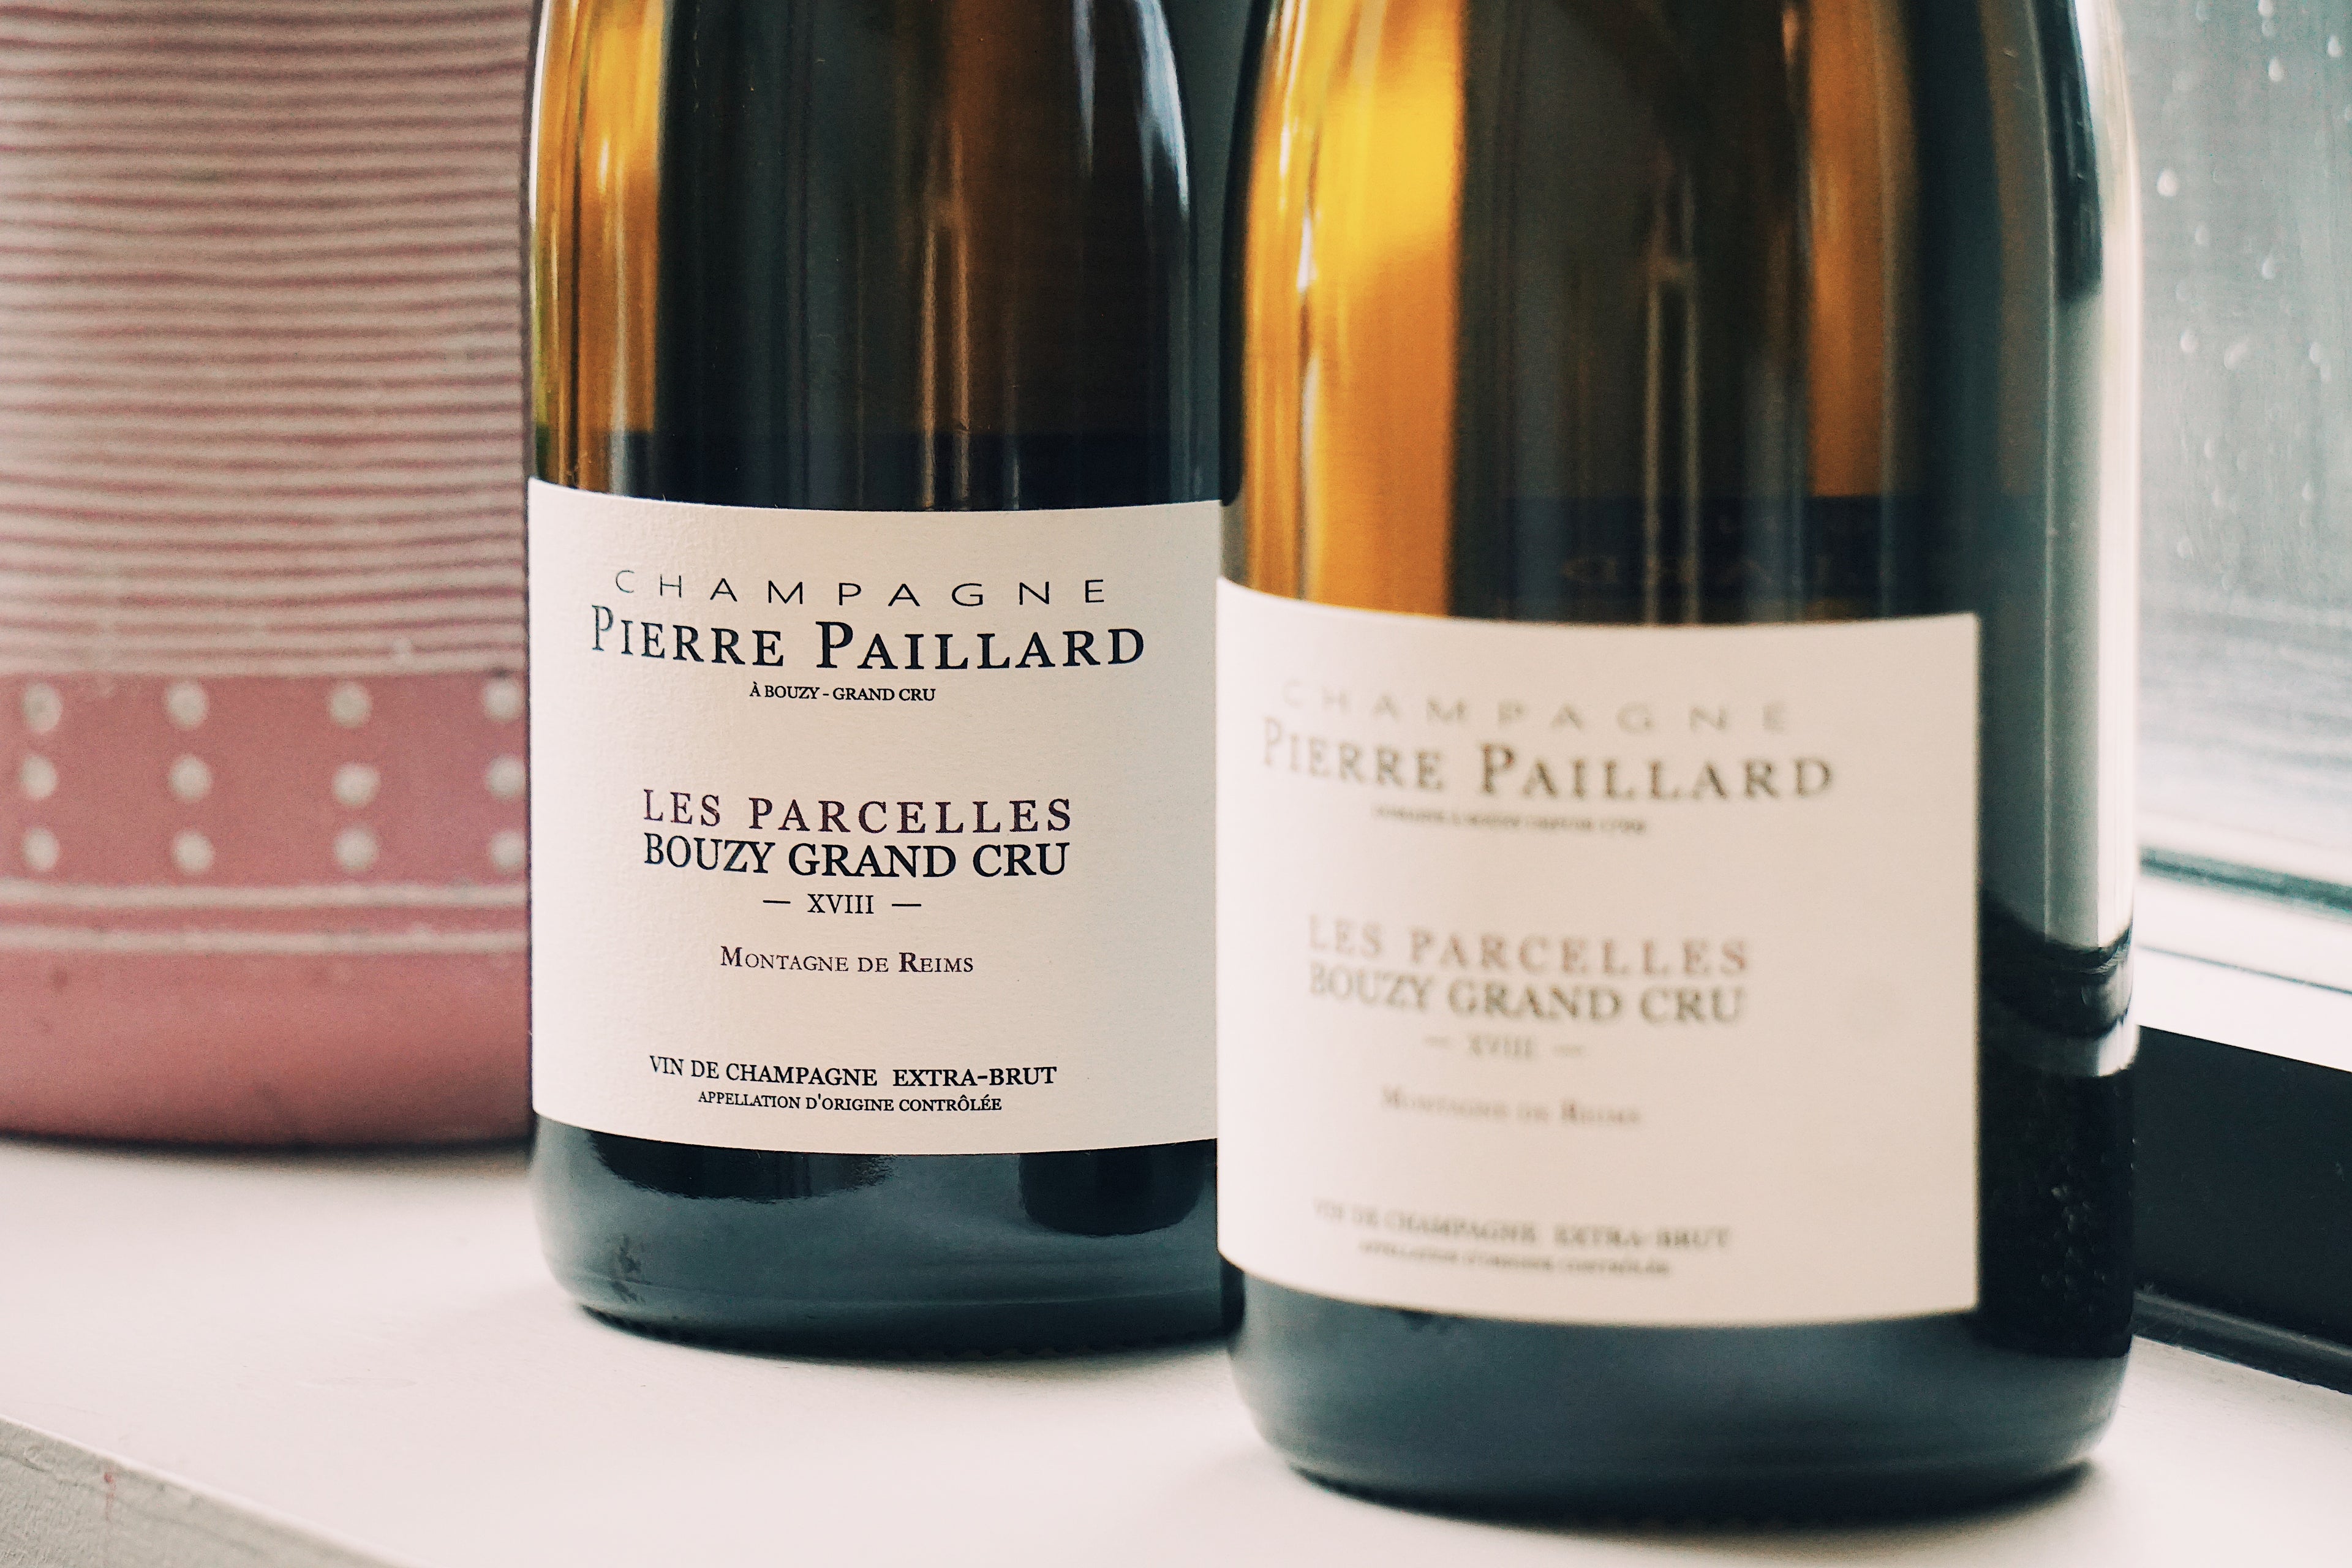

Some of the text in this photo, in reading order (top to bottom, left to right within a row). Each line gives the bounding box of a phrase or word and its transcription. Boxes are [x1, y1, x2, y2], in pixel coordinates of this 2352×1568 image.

[614, 569, 1106, 608] CHAMPAGNE
[591, 604, 1145, 671] PIERRE PAILLARD
[748, 680, 761, 698] À
[764, 684, 821, 701] BOUZY
[832, 686, 895, 702] GRAND
[898, 687, 937, 703] CRU
[1262, 714, 1834, 802] PIERRE PAILLARD
[643, 788, 1071, 835] LES PARCELLES
[643, 831, 1071, 879] BOUZY GRAND CRU
[807, 892, 875, 915] XVIII
[720, 944, 974, 974] MONTAGNE DE REIMS
[1308, 913, 1751, 978] LES PARCELLES
[1308, 959, 1746, 1026] BOUZY GRAND CRU
[649, 1054, 1058, 1088] VIN DE CHAMPAGNE EXTRA-BRUT
[698, 1090, 1003, 1113] APPELLATION D'ORIGINE CONTRÔLÉE
